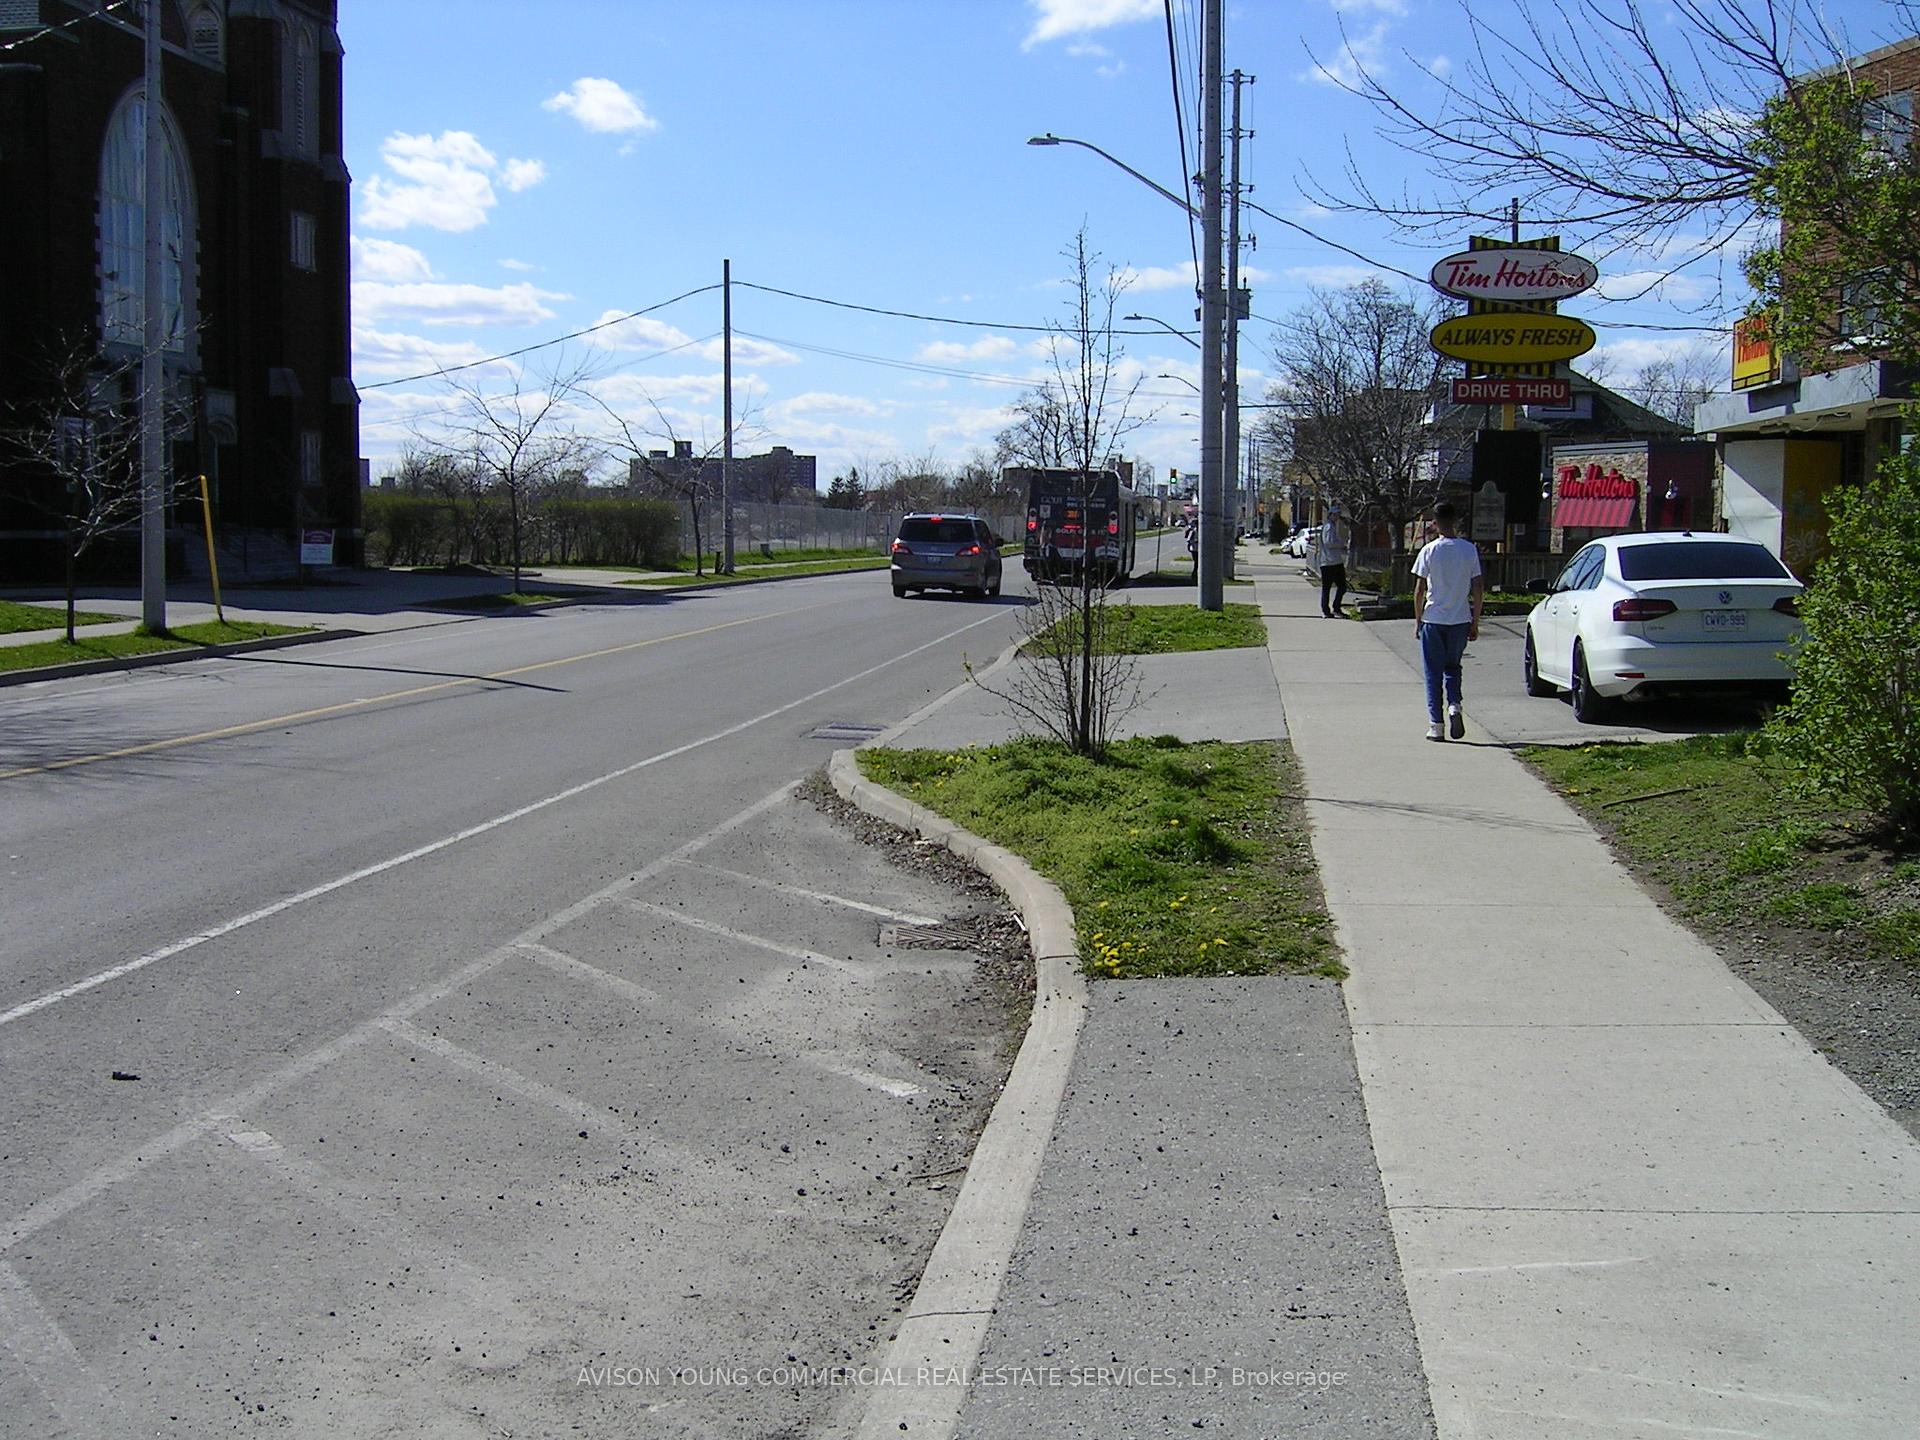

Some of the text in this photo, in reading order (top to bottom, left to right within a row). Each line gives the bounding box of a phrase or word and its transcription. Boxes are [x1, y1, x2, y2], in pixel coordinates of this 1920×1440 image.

[1446, 256, 1586, 288] Tim Hortons
[1440, 328, 1584, 346] ALWAYS FRESH
[1458, 383, 1565, 399] DRIVE THRU
[1557, 463, 1638, 499] Tim Hortons
